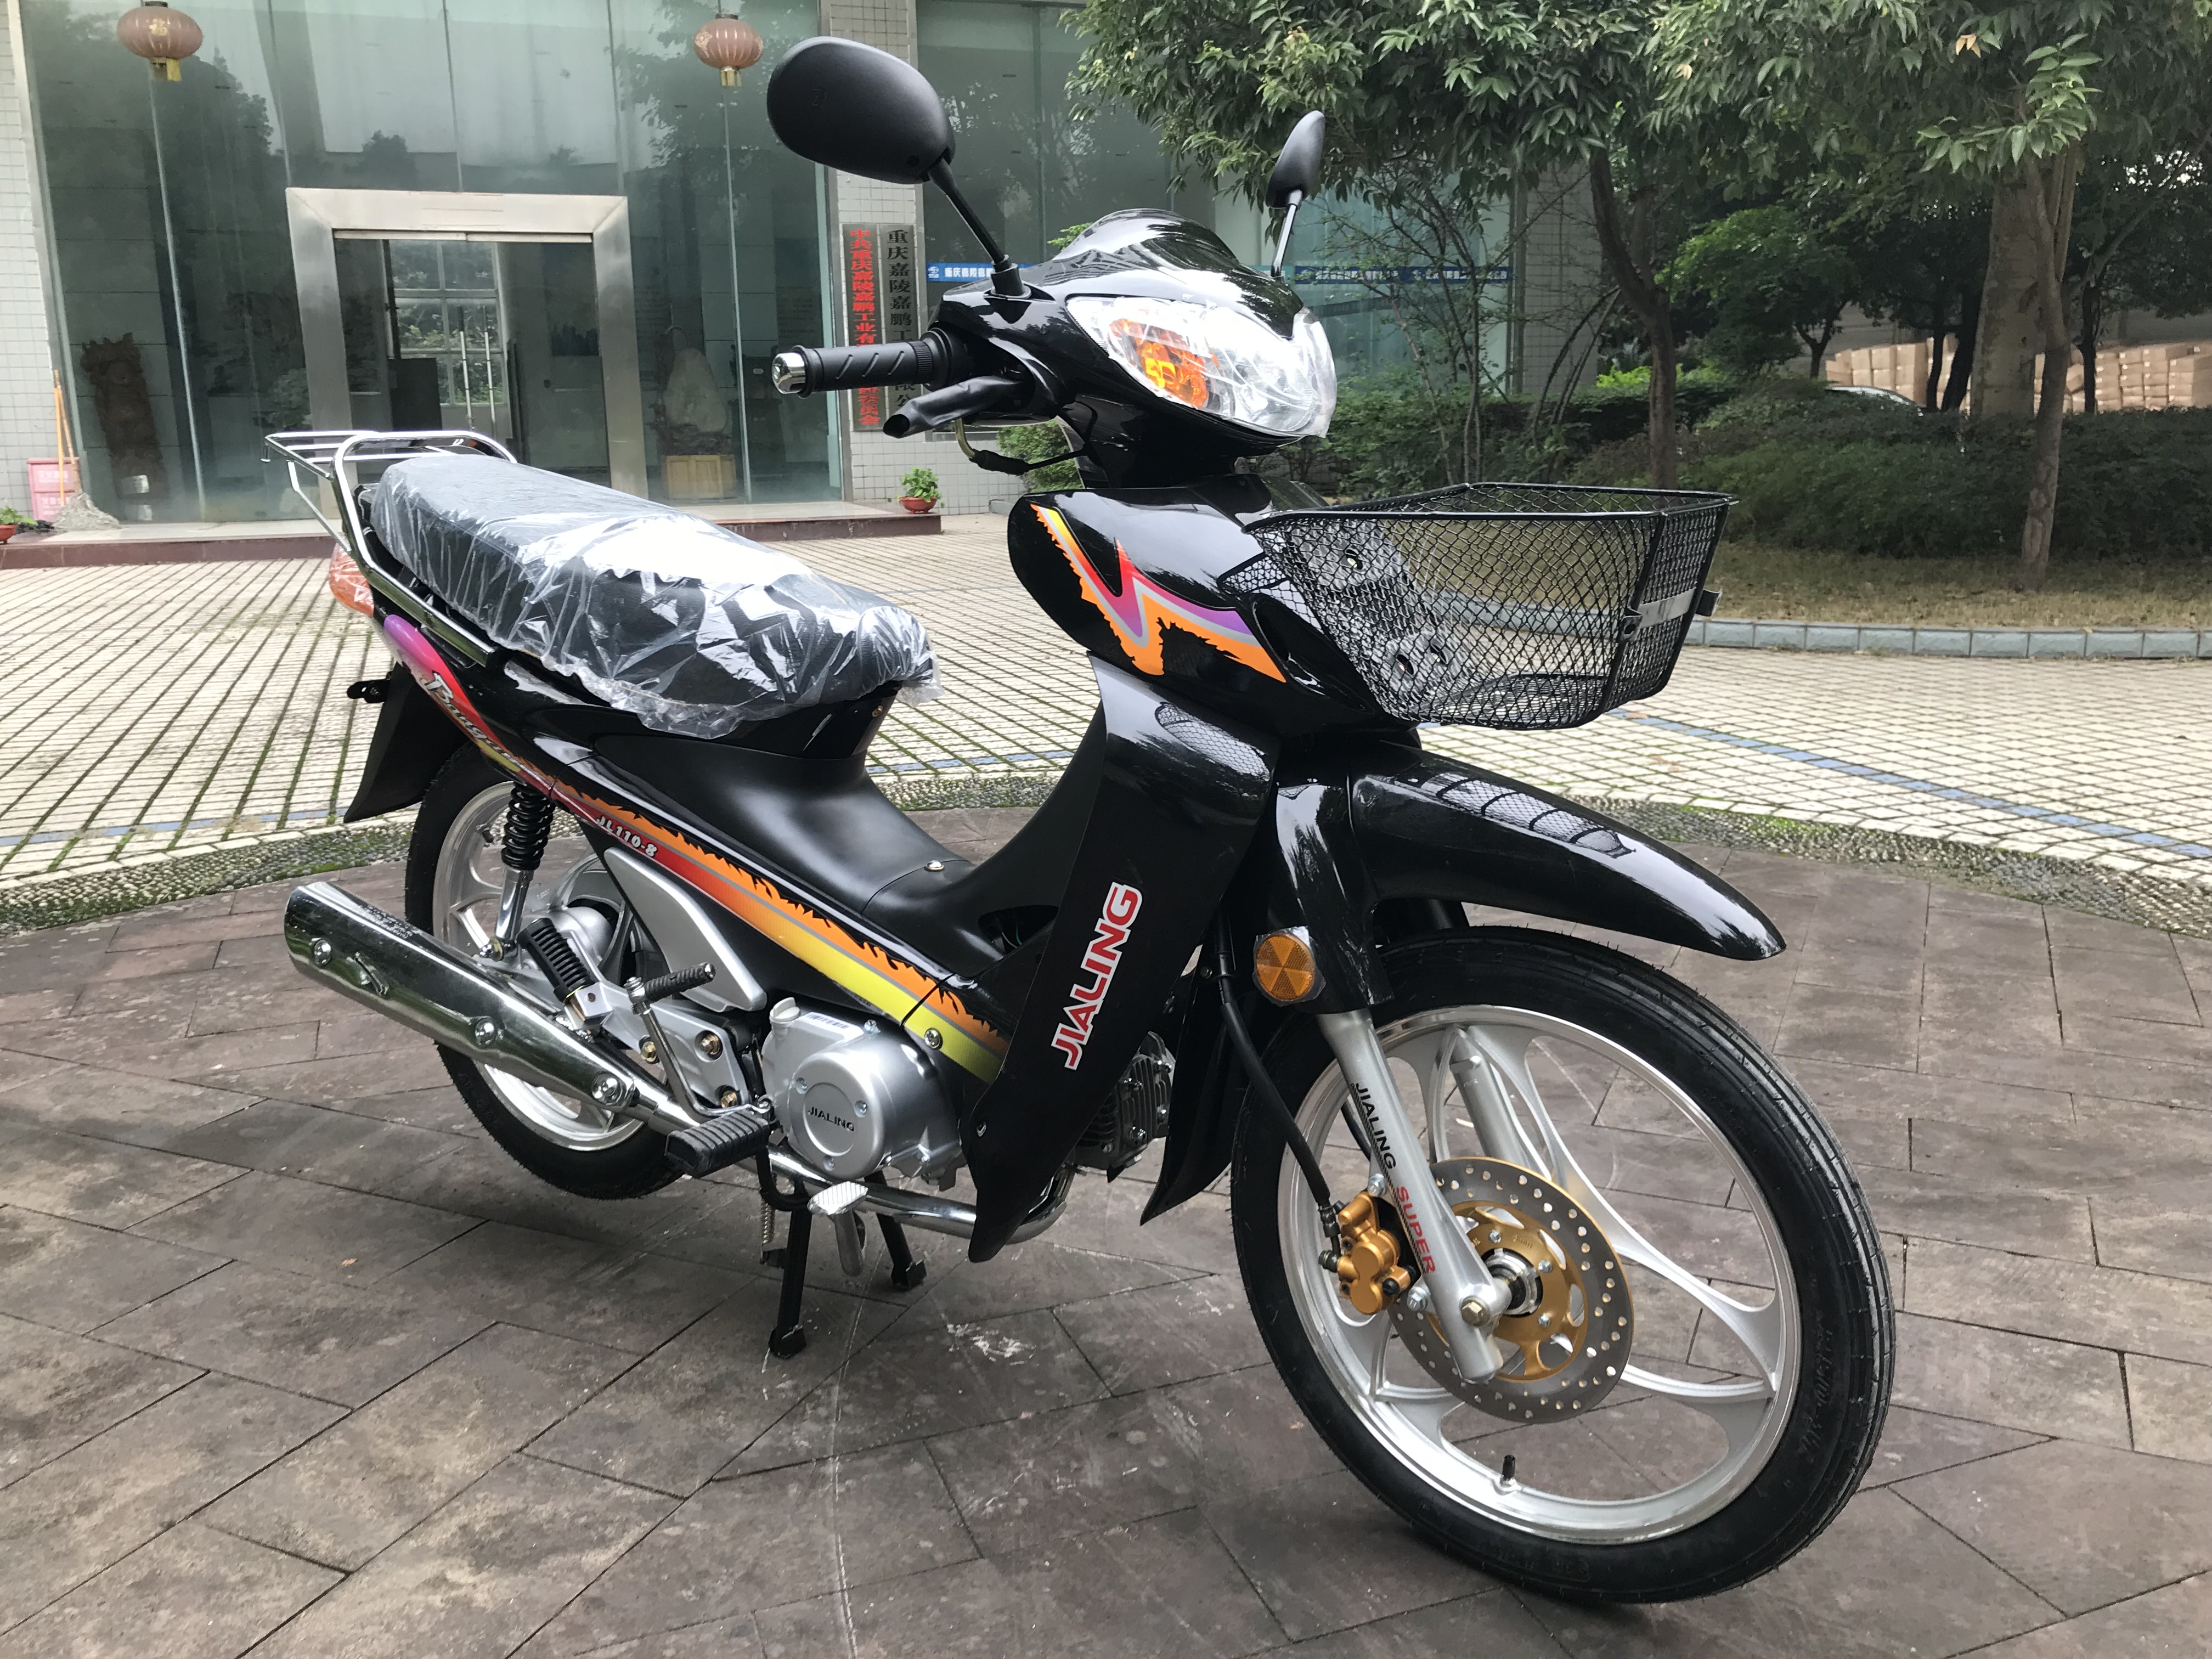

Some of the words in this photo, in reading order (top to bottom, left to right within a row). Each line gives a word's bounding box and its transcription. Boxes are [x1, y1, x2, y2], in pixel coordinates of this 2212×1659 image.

[596, 816, 657, 857] JL110-8
[1051, 882, 1142, 1070] JIALING
[807, 1106, 855, 1132] JIALING
[1355, 1082, 1396, 1169] JIALING
[1396, 1186, 1436, 1274] SUPER
